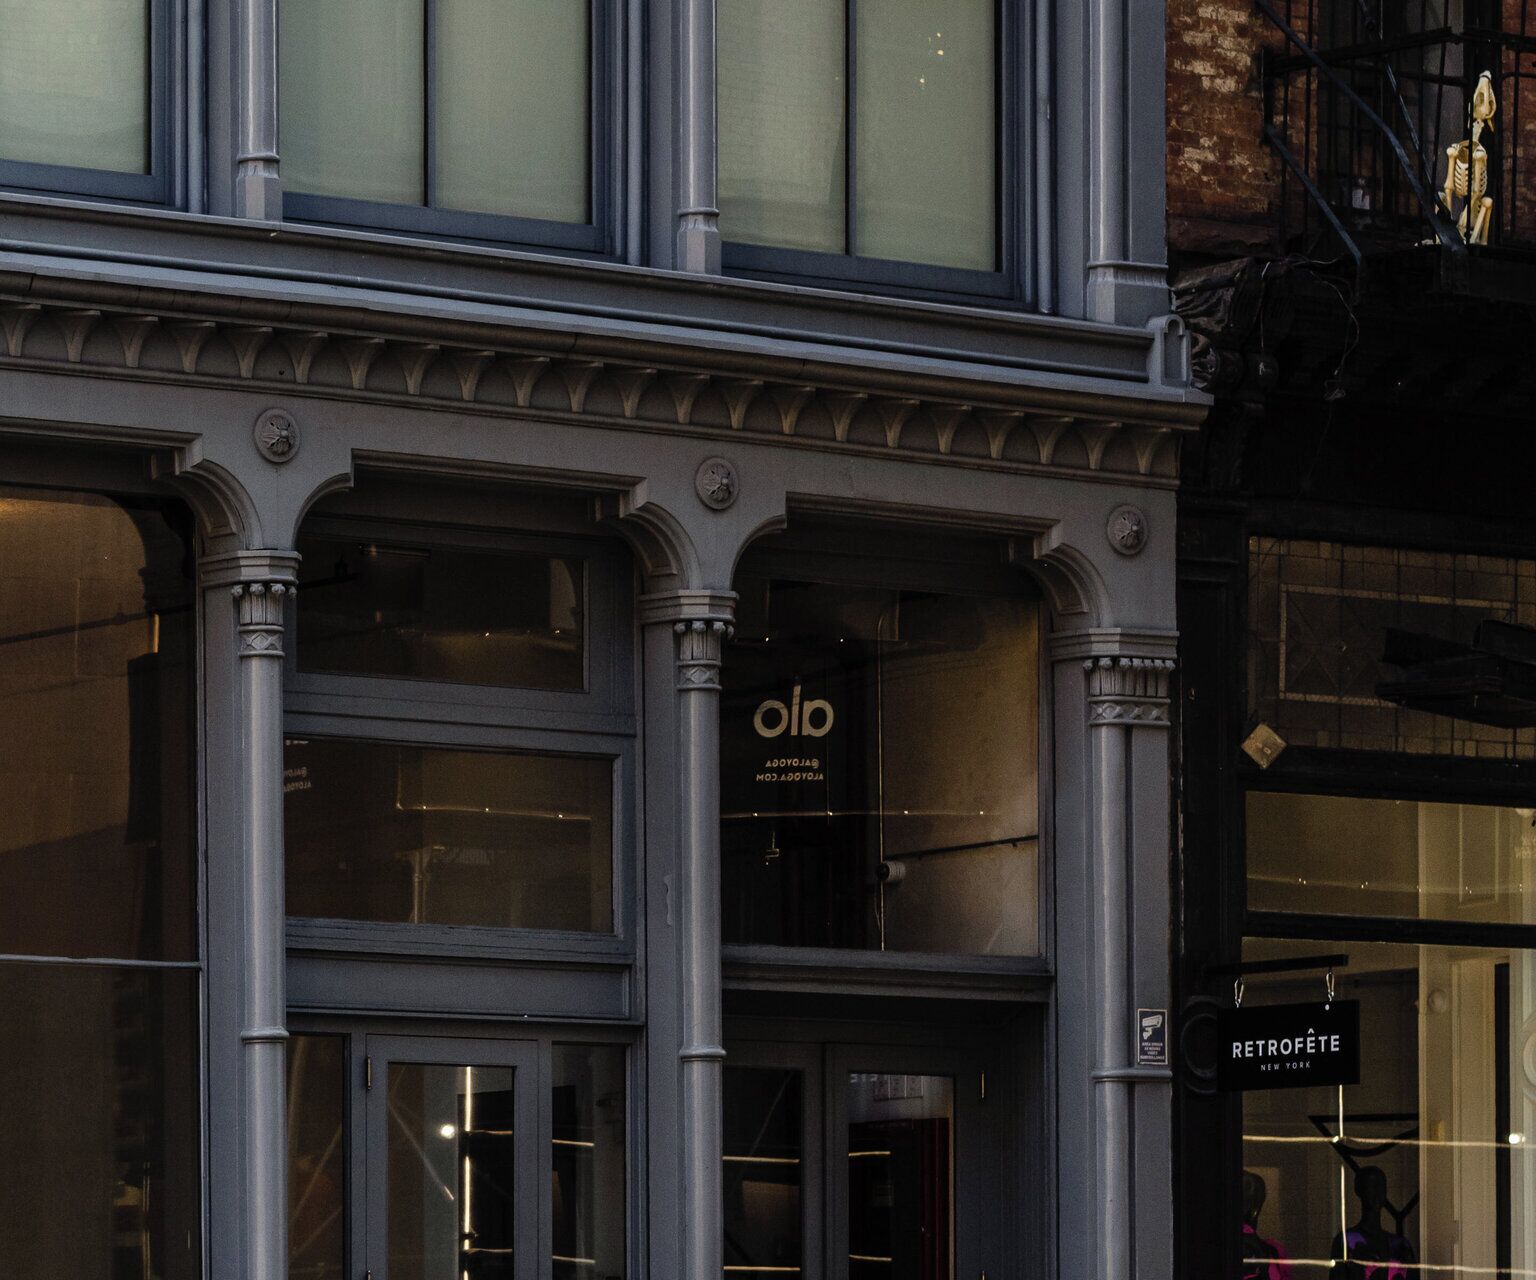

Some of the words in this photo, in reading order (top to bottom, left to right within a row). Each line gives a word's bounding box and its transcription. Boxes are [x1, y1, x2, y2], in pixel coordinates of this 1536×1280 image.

[1231, 1026, 1341, 1059] RETROFÊTE
[1260, 1062, 1280, 1072] NEW
[1285, 1060, 1311, 1071] YORK
